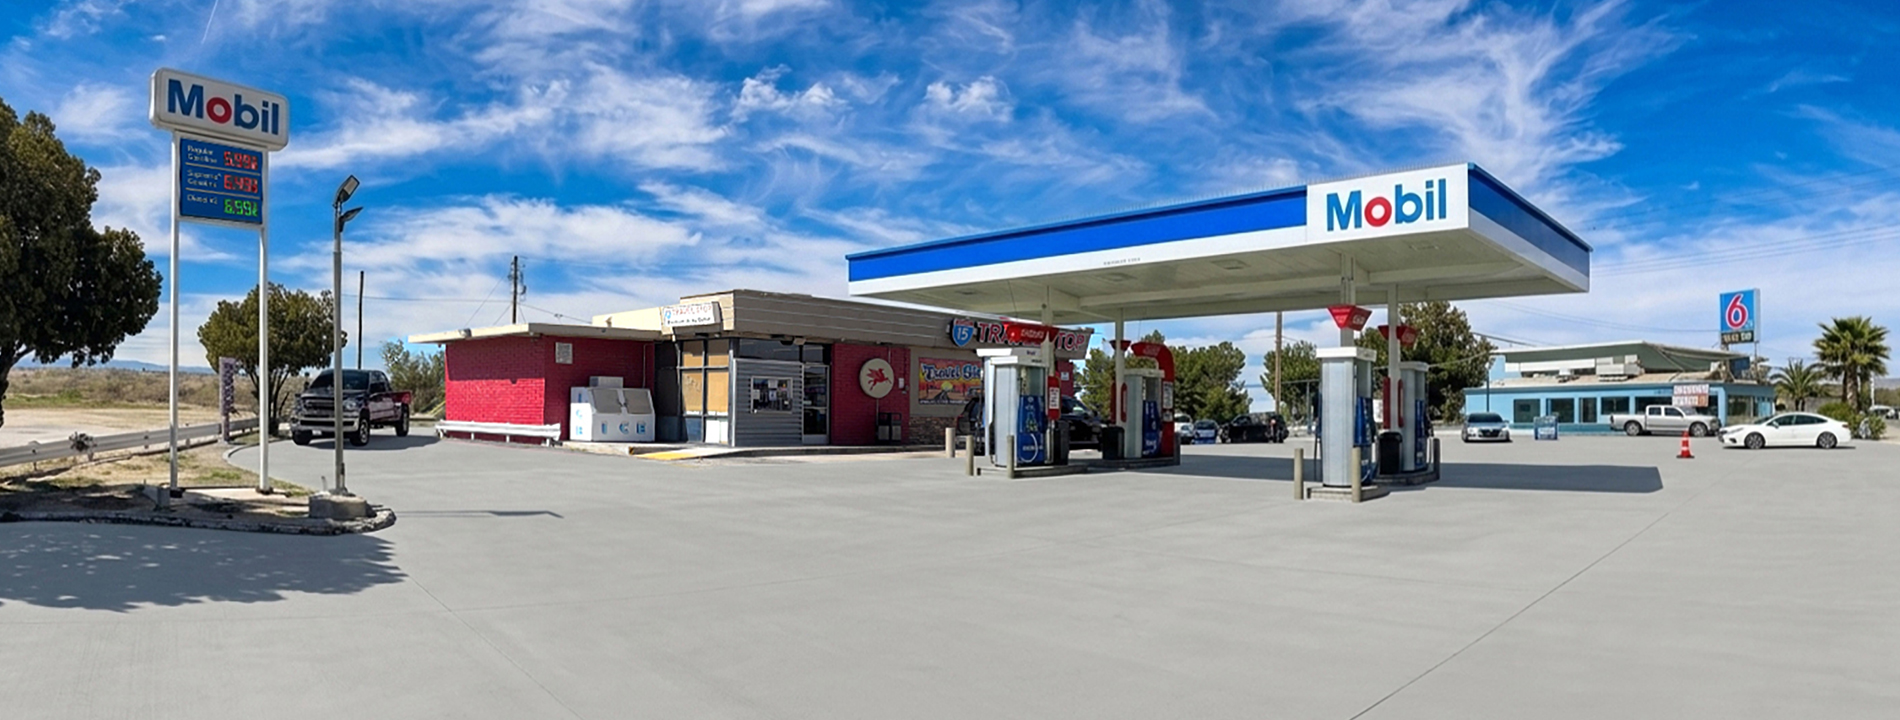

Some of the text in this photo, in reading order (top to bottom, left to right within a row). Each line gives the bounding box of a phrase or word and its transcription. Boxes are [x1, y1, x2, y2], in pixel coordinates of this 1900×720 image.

[168, 79, 279, 135] Mobil
[1326, 178, 1447, 232] Mobil
[1726, 293, 1748, 329] 6
[957, 327, 969, 341] 15
[1056, 332, 1085, 351] TOP
